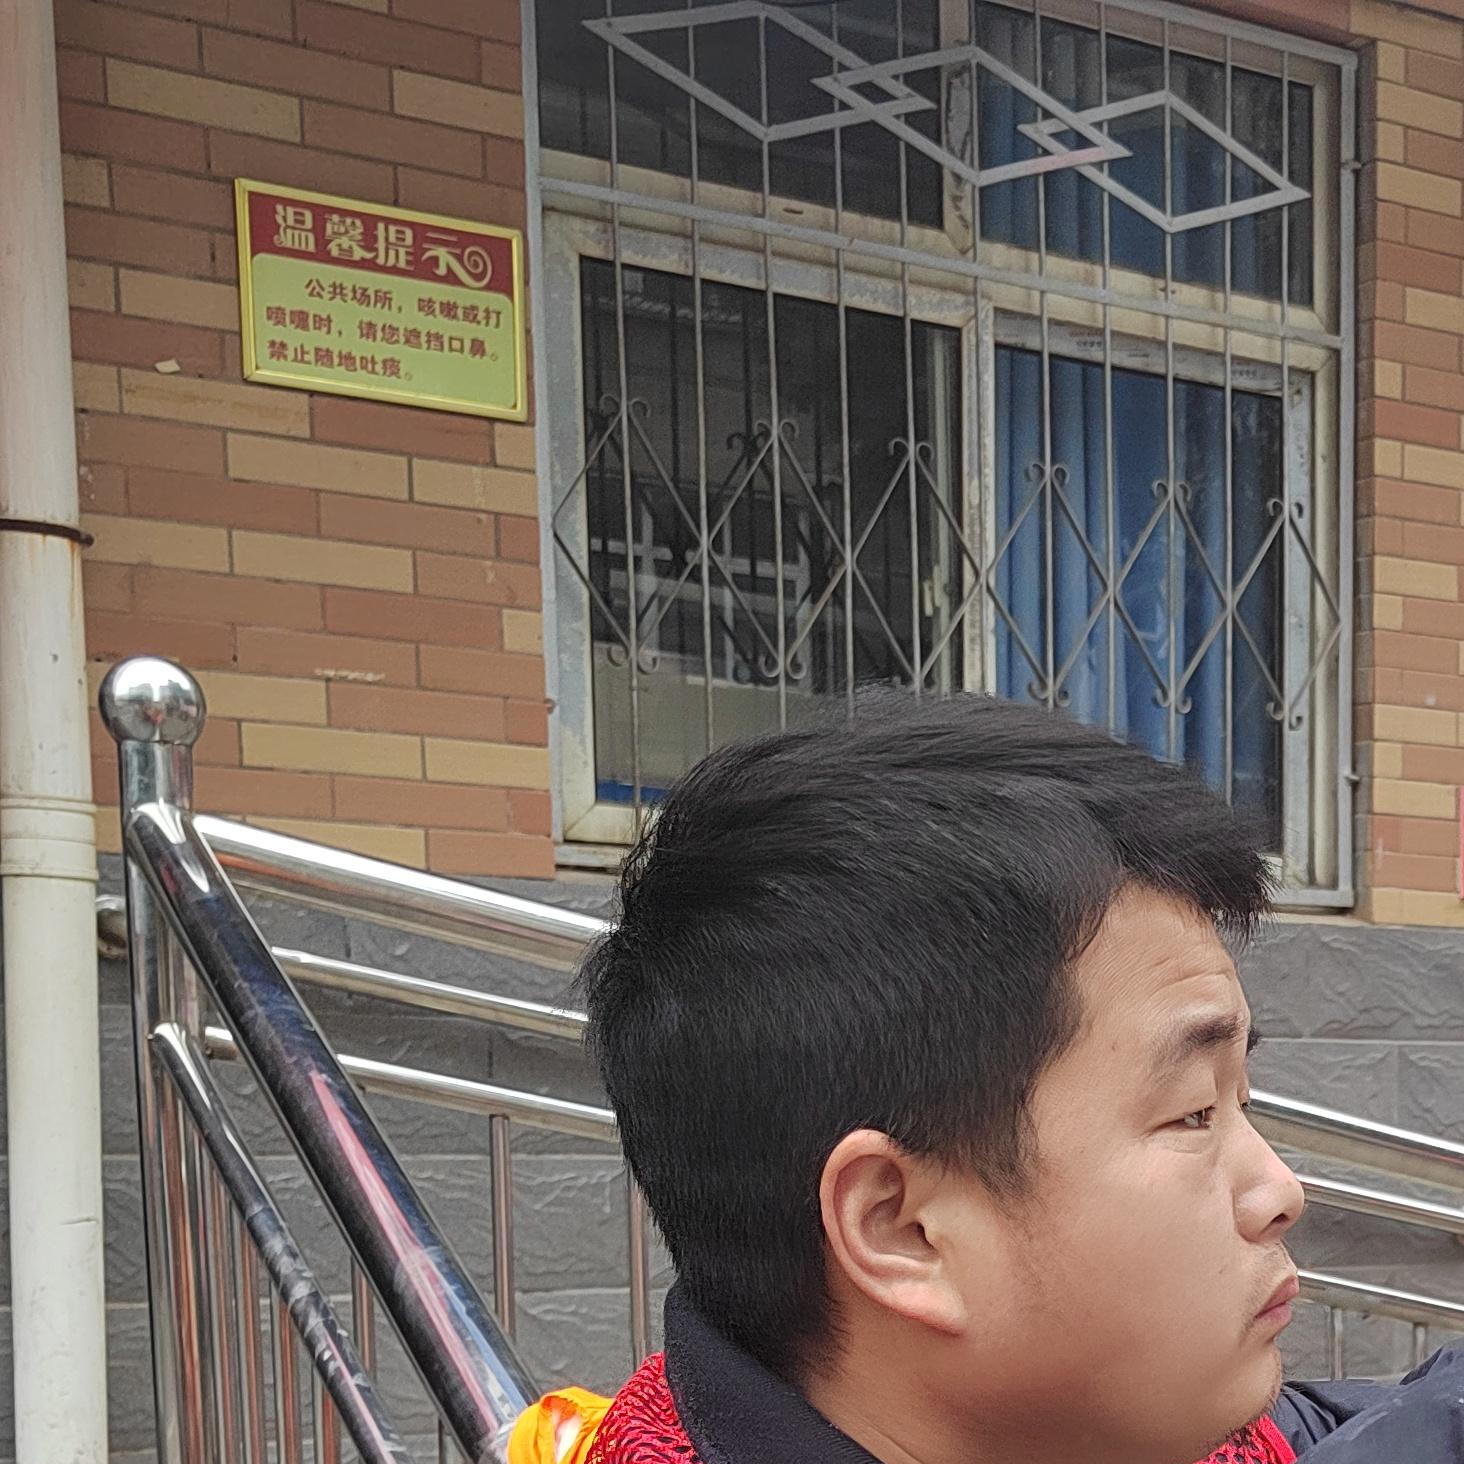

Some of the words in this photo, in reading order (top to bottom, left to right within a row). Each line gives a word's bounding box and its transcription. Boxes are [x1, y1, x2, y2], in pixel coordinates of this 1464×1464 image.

[273, 203, 493, 289] 温馨提示
[304, 277, 502, 329] 公共场所，咳嗽或打
[265, 305, 499, 363] 喷嚏时，请您遮挡口鼻。
[267, 338, 413, 382] 禁止随地吐痰。
